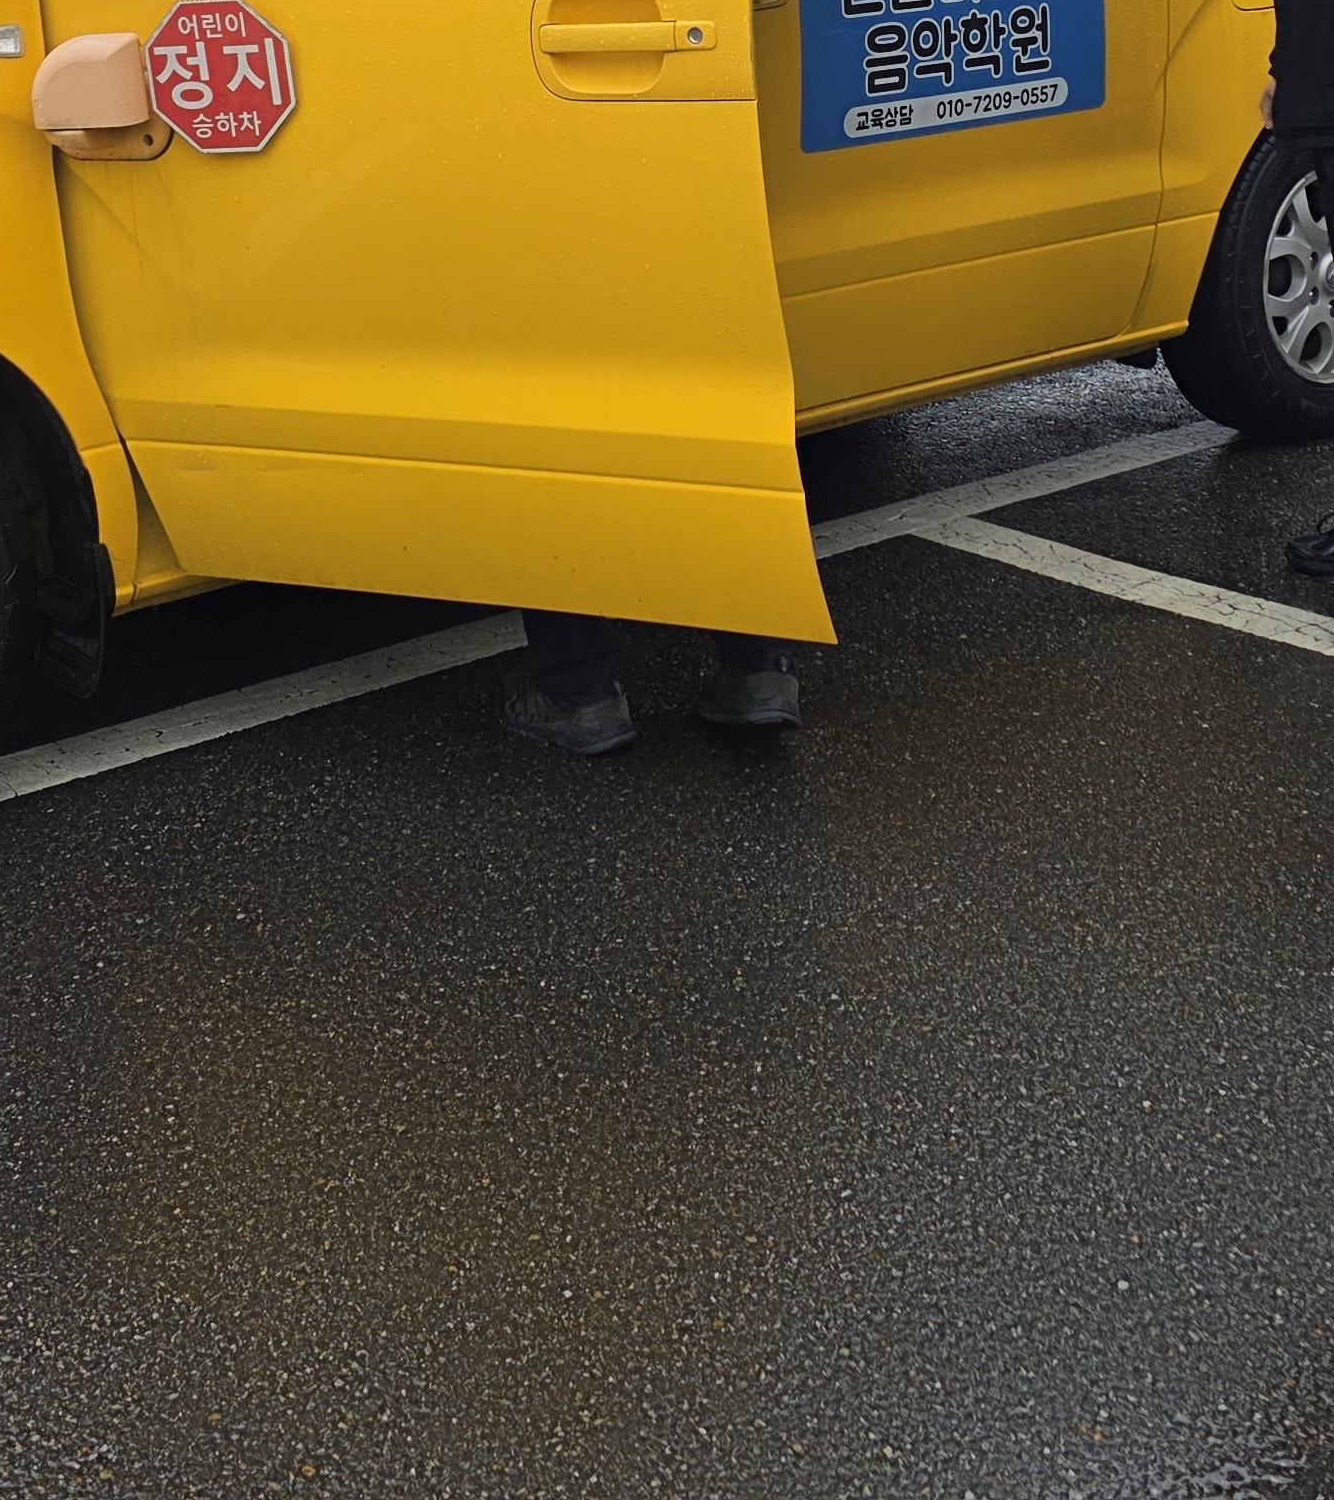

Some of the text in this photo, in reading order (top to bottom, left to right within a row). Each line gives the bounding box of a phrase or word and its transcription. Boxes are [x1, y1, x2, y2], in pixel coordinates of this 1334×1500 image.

[178, 12, 247, 39] 어린이
[863, 3, 1051, 96] 음악학원
[154, 38, 281, 109] 정지
[192, 111, 261, 138] 승하차
[855, 84, 1059, 131] 교육상담 010-7209-0557
